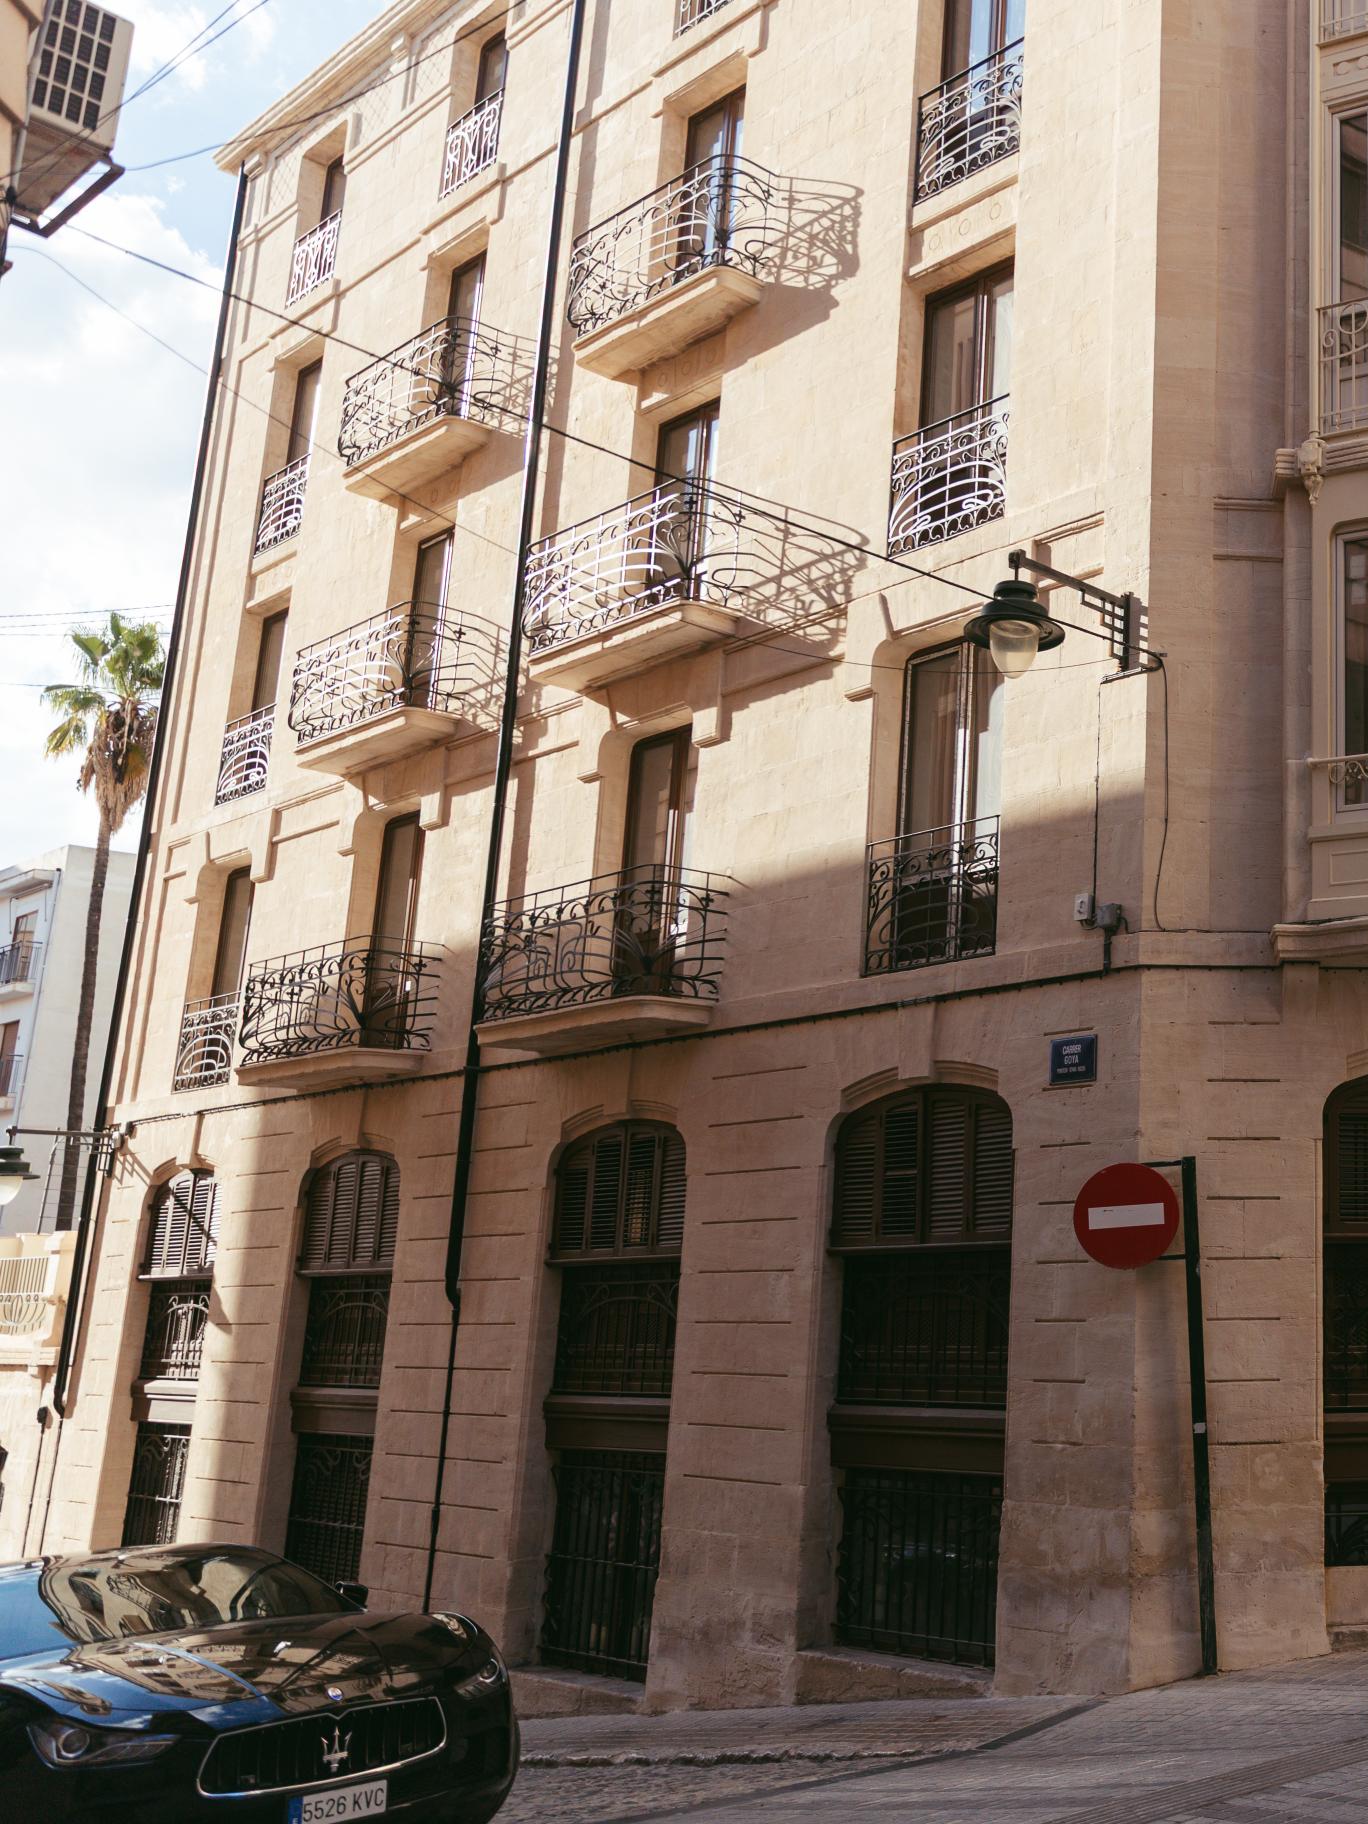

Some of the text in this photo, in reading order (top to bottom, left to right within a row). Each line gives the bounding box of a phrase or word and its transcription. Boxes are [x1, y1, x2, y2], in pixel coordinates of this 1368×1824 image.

[1062, 1045, 1081, 1055] CARRER
[1064, 1055, 1079, 1065] GOYA
[303, 1787, 384, 1822] 5526 KVC
